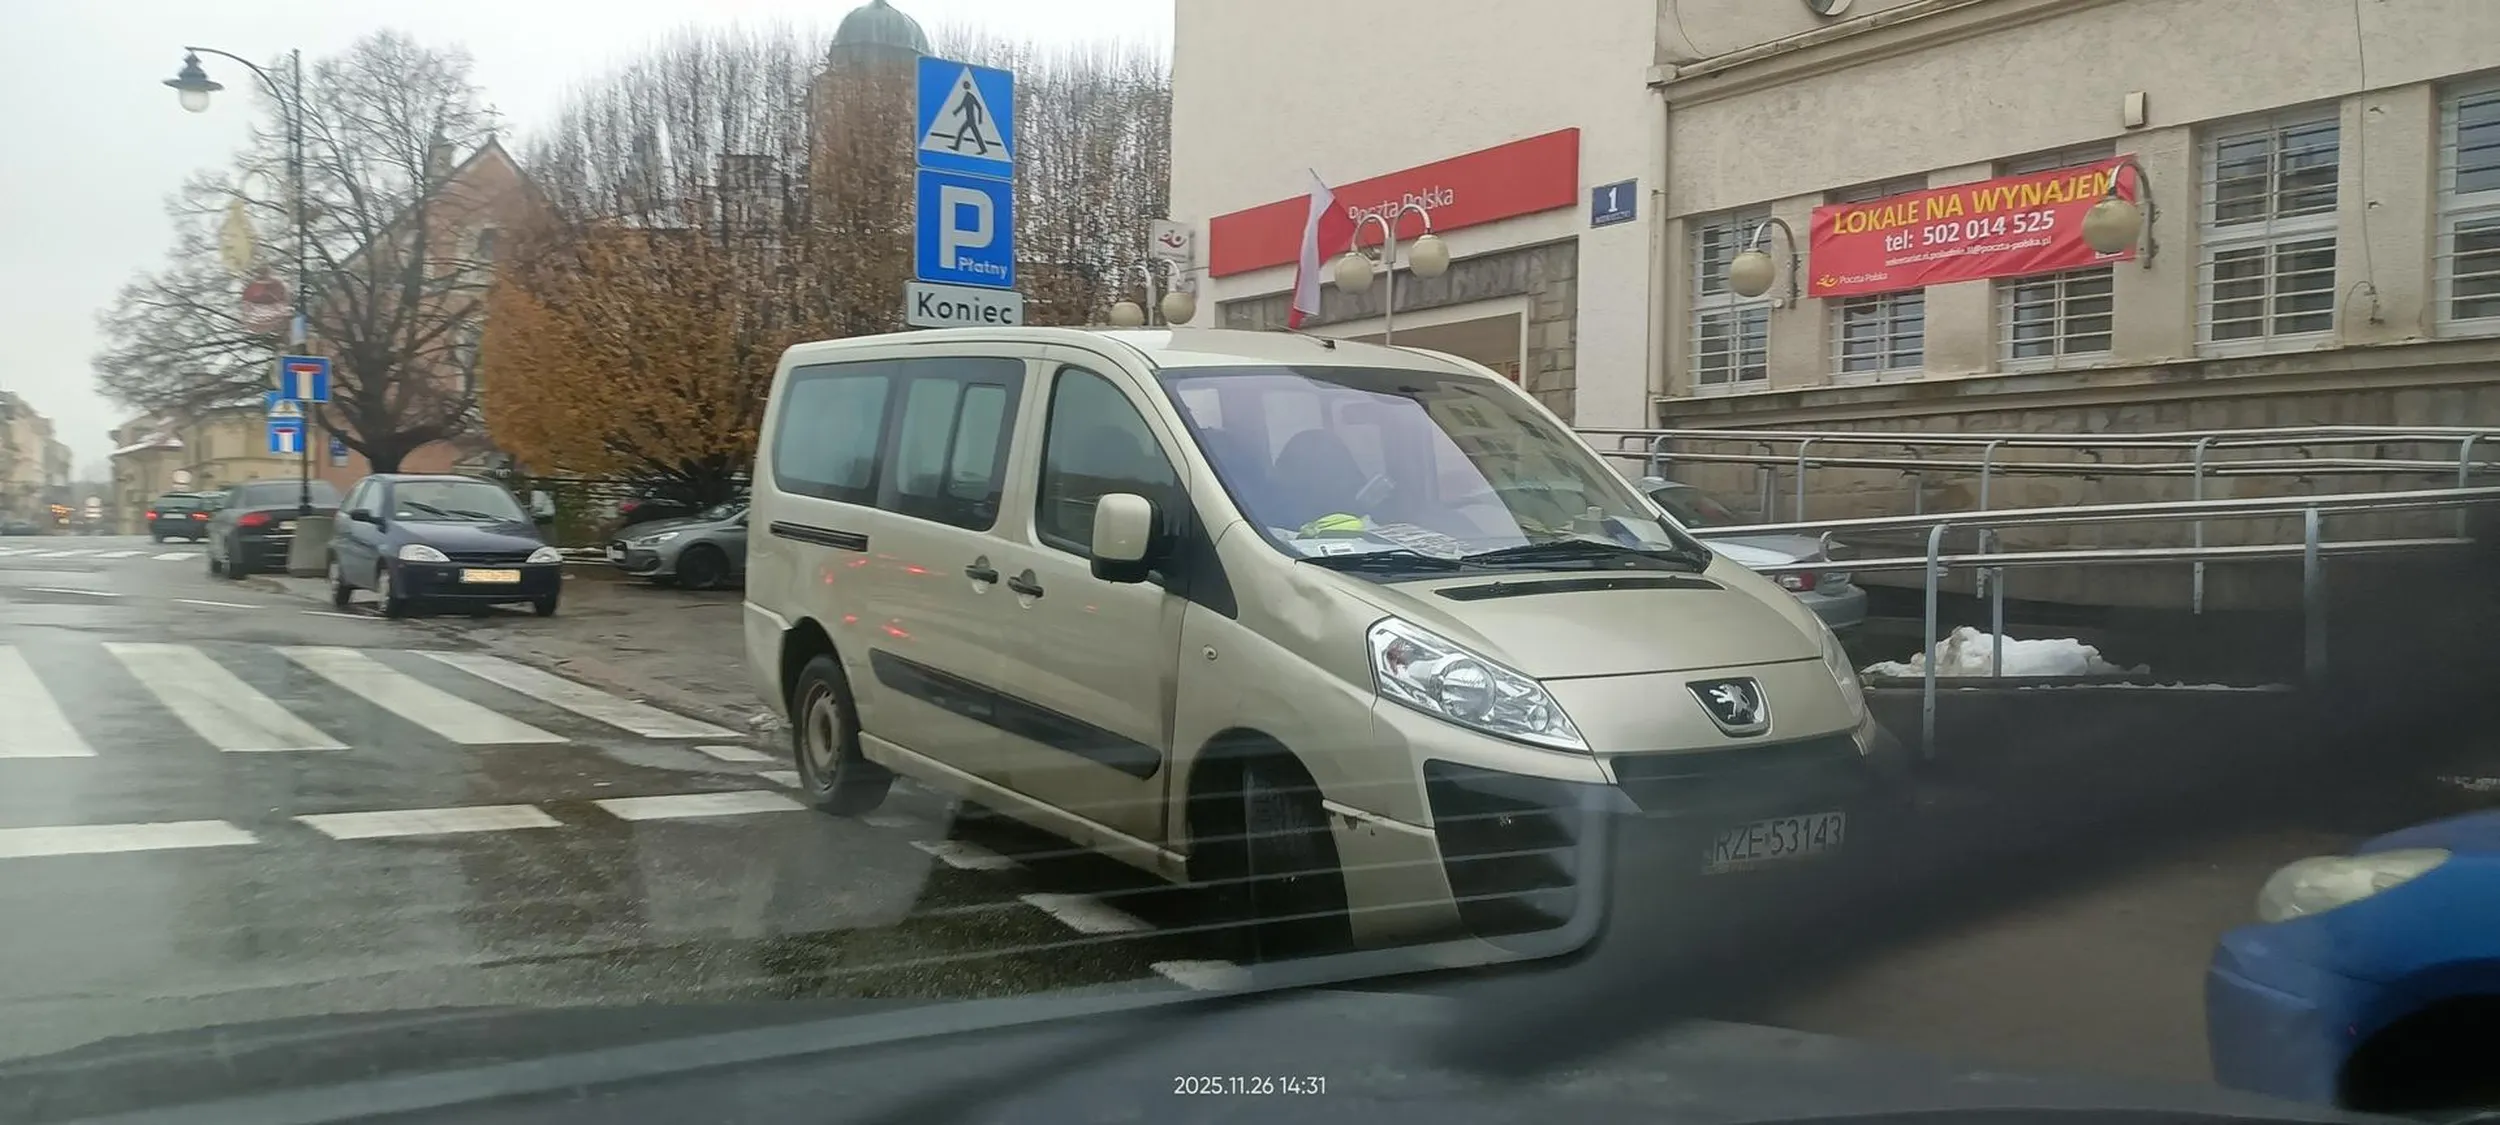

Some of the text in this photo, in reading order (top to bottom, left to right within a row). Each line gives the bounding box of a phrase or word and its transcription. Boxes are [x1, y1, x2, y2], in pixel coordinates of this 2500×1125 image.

[1608, 187, 1618, 212] 1
[1833, 200, 1920, 235] LOKALE
[1926, 191, 1964, 221] NA
[939, 184, 994, 269] P
[1885, 210, 2055, 252] tel: 502 014 525
[958, 255, 1008, 280] Płatny
[917, 291, 1014, 324] Koniec
[1715, 815, 1842, 862] RZE 53143
